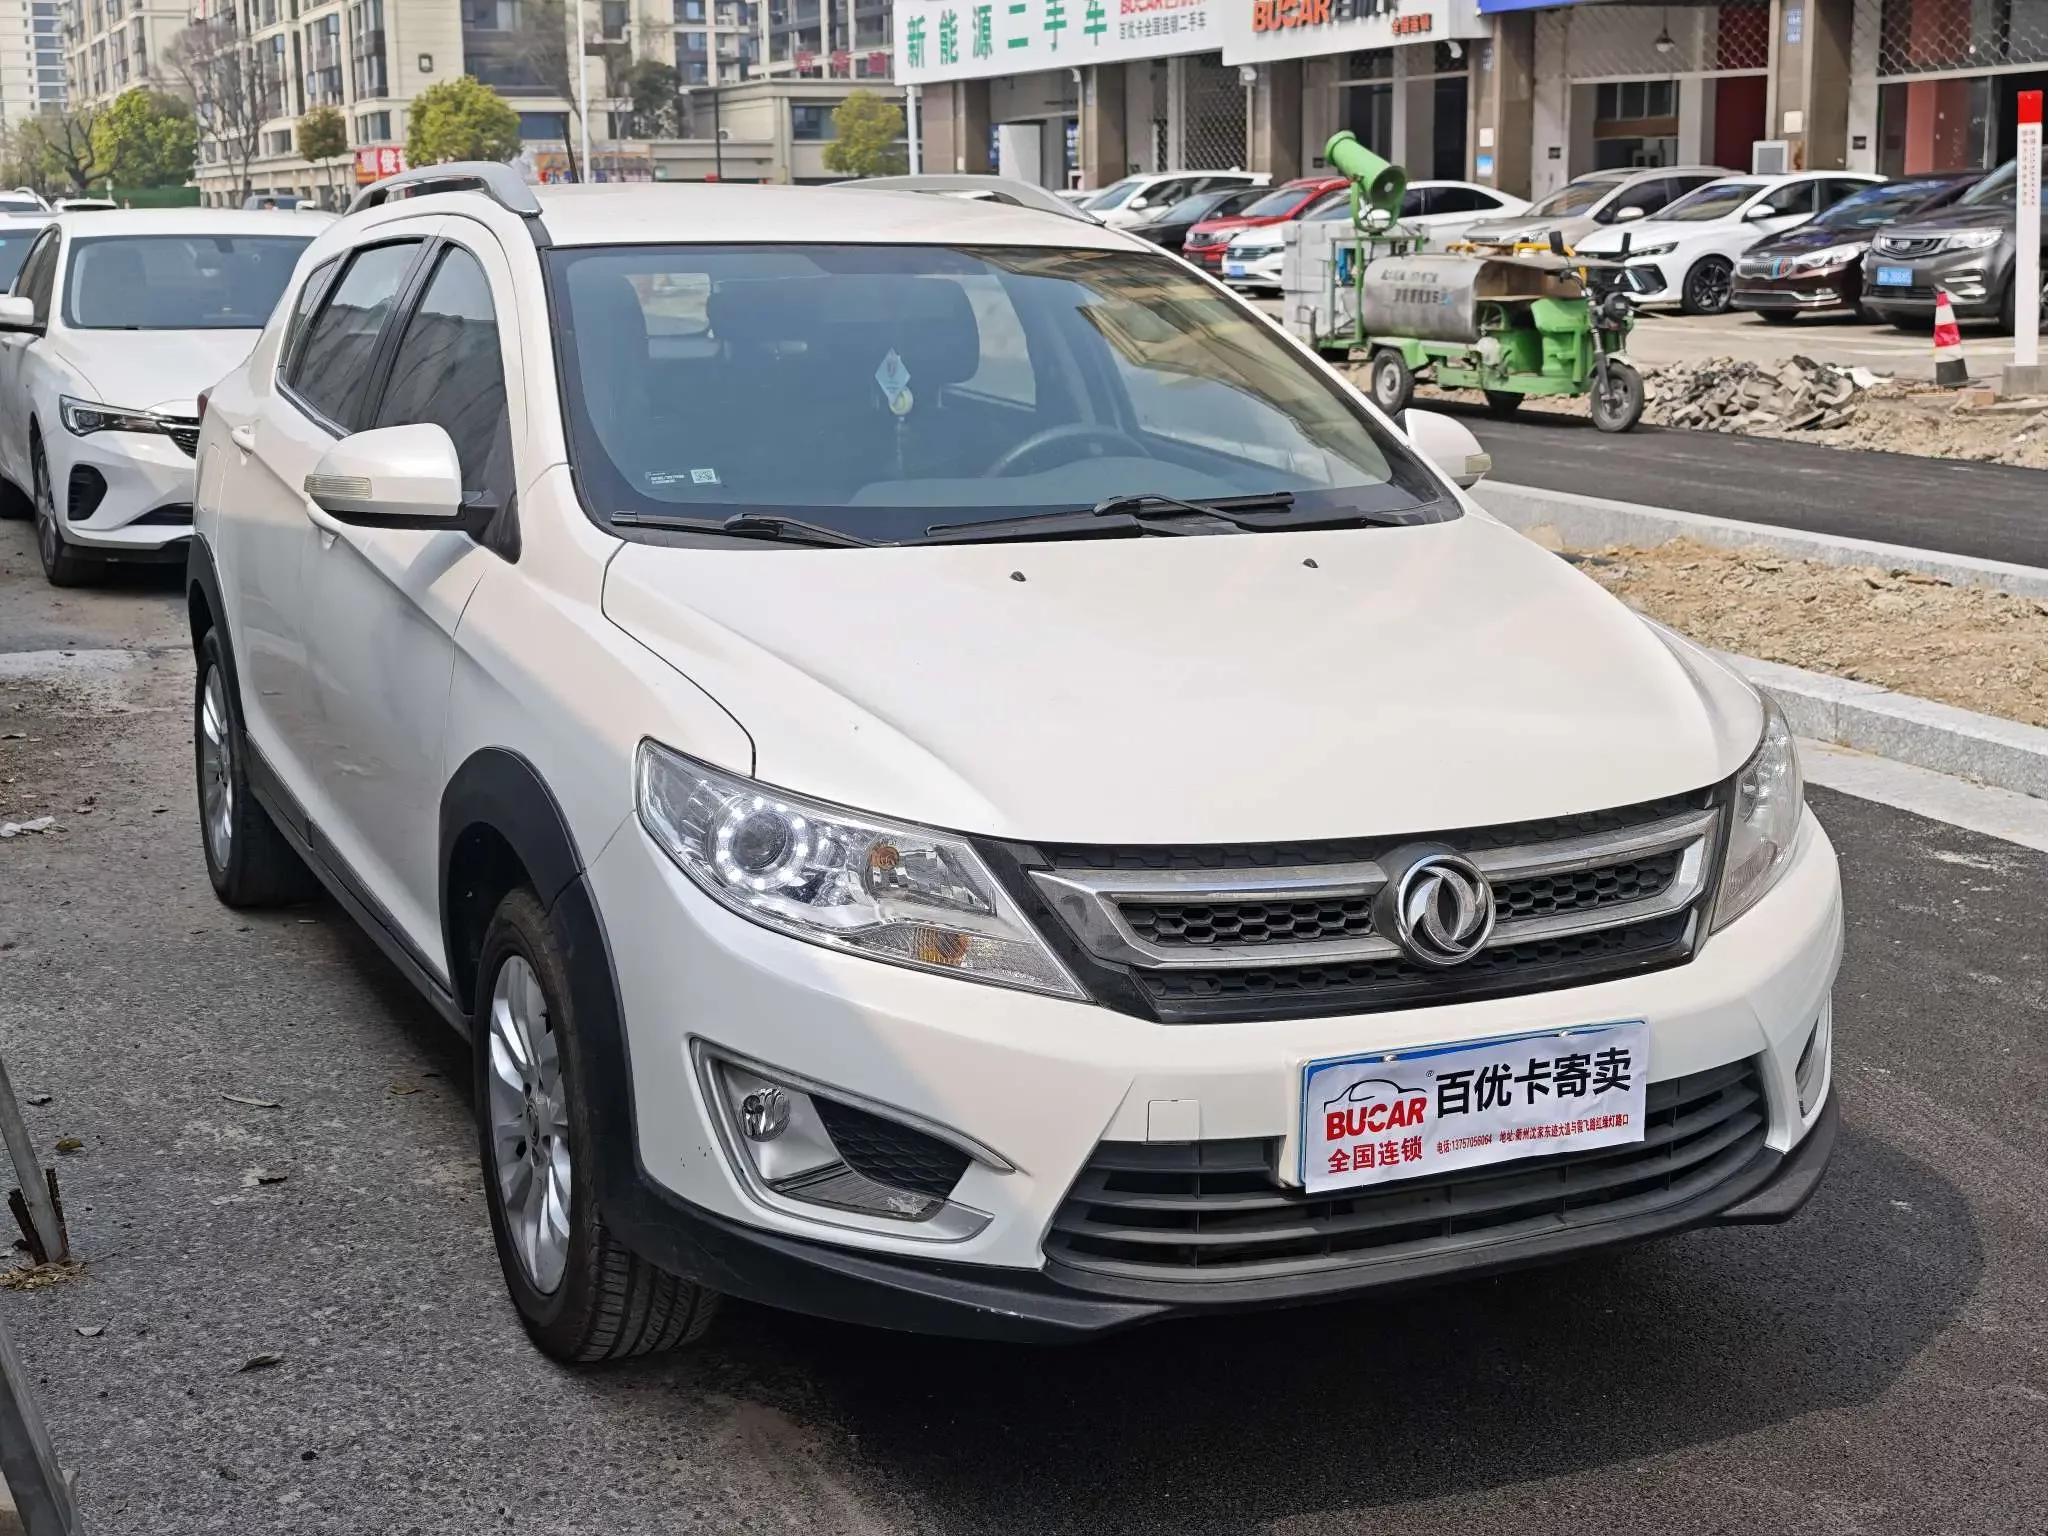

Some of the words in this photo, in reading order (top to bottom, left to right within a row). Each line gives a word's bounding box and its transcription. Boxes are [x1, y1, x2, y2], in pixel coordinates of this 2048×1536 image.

[908, 0, 1107, 68] 新能源二手车
[1436, 1047, 1631, 1118] 百优卡寄卖
[1326, 1097, 1427, 1141] BUCAR
[1328, 1135, 1423, 1174] 全国连锁
